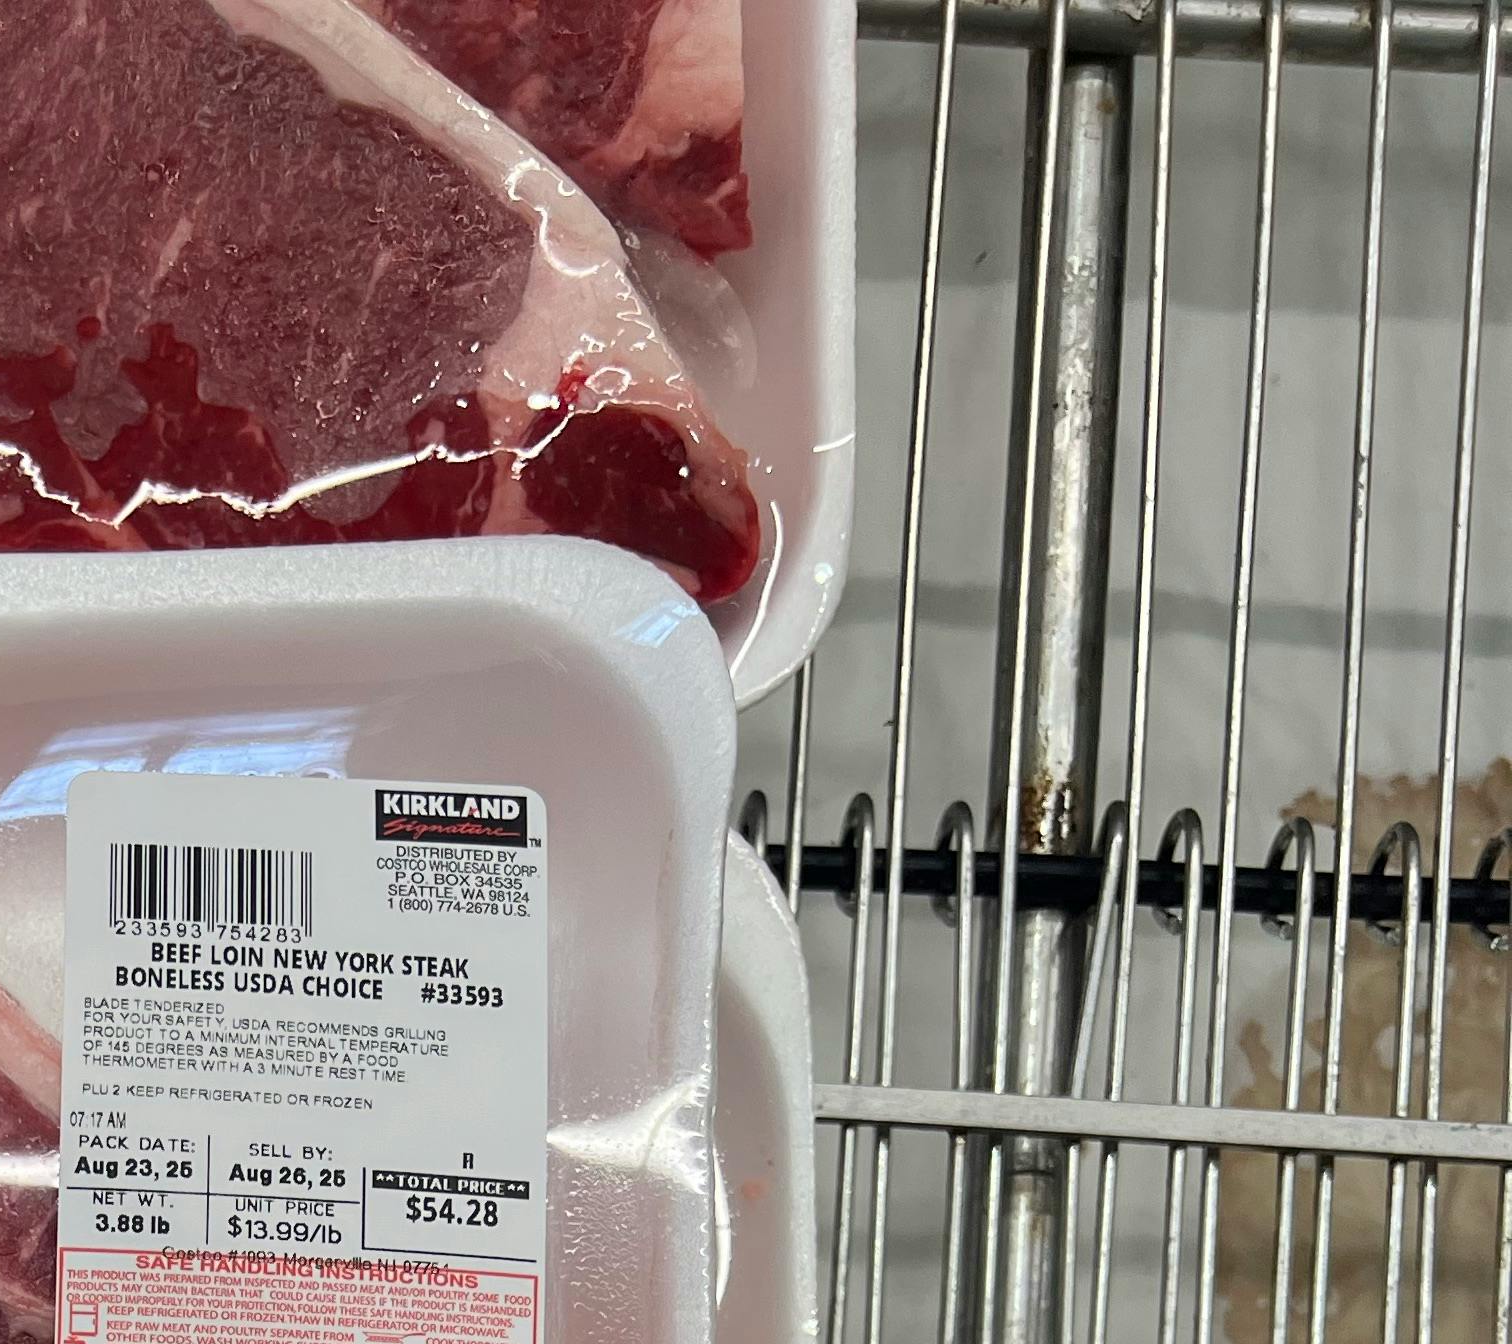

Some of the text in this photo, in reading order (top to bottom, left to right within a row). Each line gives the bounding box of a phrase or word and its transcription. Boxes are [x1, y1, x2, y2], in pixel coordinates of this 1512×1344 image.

[383, 793, 520, 820] KIRKLAND
[383, 818, 521, 840] Signature
[396, 845, 517, 863] DISTRIBUTED BY
[376, 857, 427, 871] COSTCO
[429, 861, 501, 876] WHOLESALE
[395, 871, 523, 890] P.O. BOX 34535
[461, 888, 485, 901] WA
[489, 890, 530, 903] 98124
[389, 898, 531, 918] 1 (800) 774-2678 U.S.
[115, 920, 302, 944] 233593 754283
[151, 942, 469, 979] BEEF LOIN NEW YORK STEAK
[116, 966, 504, 1008] BONELESS USDA CHOICE #33593
[84, 997, 225, 1015] BLADE TENDERIZED
[83, 1011, 115, 1023] FOR
[120, 1013, 162, 1026] YOUR
[232, 1018, 270, 1031] USDA
[276, 1020, 378, 1037] RECOMMENDS
[384, 1026, 446, 1042] GRILLING
[83, 1025, 449, 1057] PRODUCT TO A MINIMUM INTERNAL TEMPERATURE
[83, 1039, 399, 1068] OF 145 DEGREES AS MEASURED BY A FOOD
[82, 1054, 198, 1071] THERMOMETER
[201, 1060, 239, 1073] WITH
[243, 1062, 253, 1074] A
[257, 1063, 265, 1074] 3
[271, 1063, 324, 1078] MINUTE
[328, 1067, 366, 1080] REST
[82, 1083, 373, 1110] PLU 2 KEEP REFRIGERATED OR FROZEN
[107, 1111, 127, 1129] AM
[79, 1134, 196, 1154] PACK DATE:
[248, 1143, 333, 1161] SELL BY:
[74, 1156, 119, 1179] Aug
[125, 1158, 159, 1182] 23,
[229, 1163, 272, 1186] Aug
[279, 1166, 313, 1190] 26,
[92, 1191, 174, 1209] NET WT.
[235, 1198, 335, 1217] UNIT PRICE
[406, 1194, 499, 1227] $54.28
[95, 1213, 171, 1235] 3.88 lb
[227, 1214, 342, 1245] $13.99/lb
[136, 1255, 478, 1289] SAFE HANDLING INSTRUCTIONS
[106, 1305, 135, 1316] KEEP
[137, 1306, 219, 1320] REFRIGERATED
[221, 1310, 237, 1320] OR
[240, 1311, 285, 1324] FROZEN
[287, 1313, 322, 1326] THAW
[323, 1316, 335, 1327] IN
[338, 1317, 419, 1332] REFRIGERATOR
[421, 1322, 437, 1333] OR
[106, 1320, 355, 1342] KEEP RAW MEAT AND POULTRY SEPARATE FROM
[106, 1332, 147, 1344] OTHER
